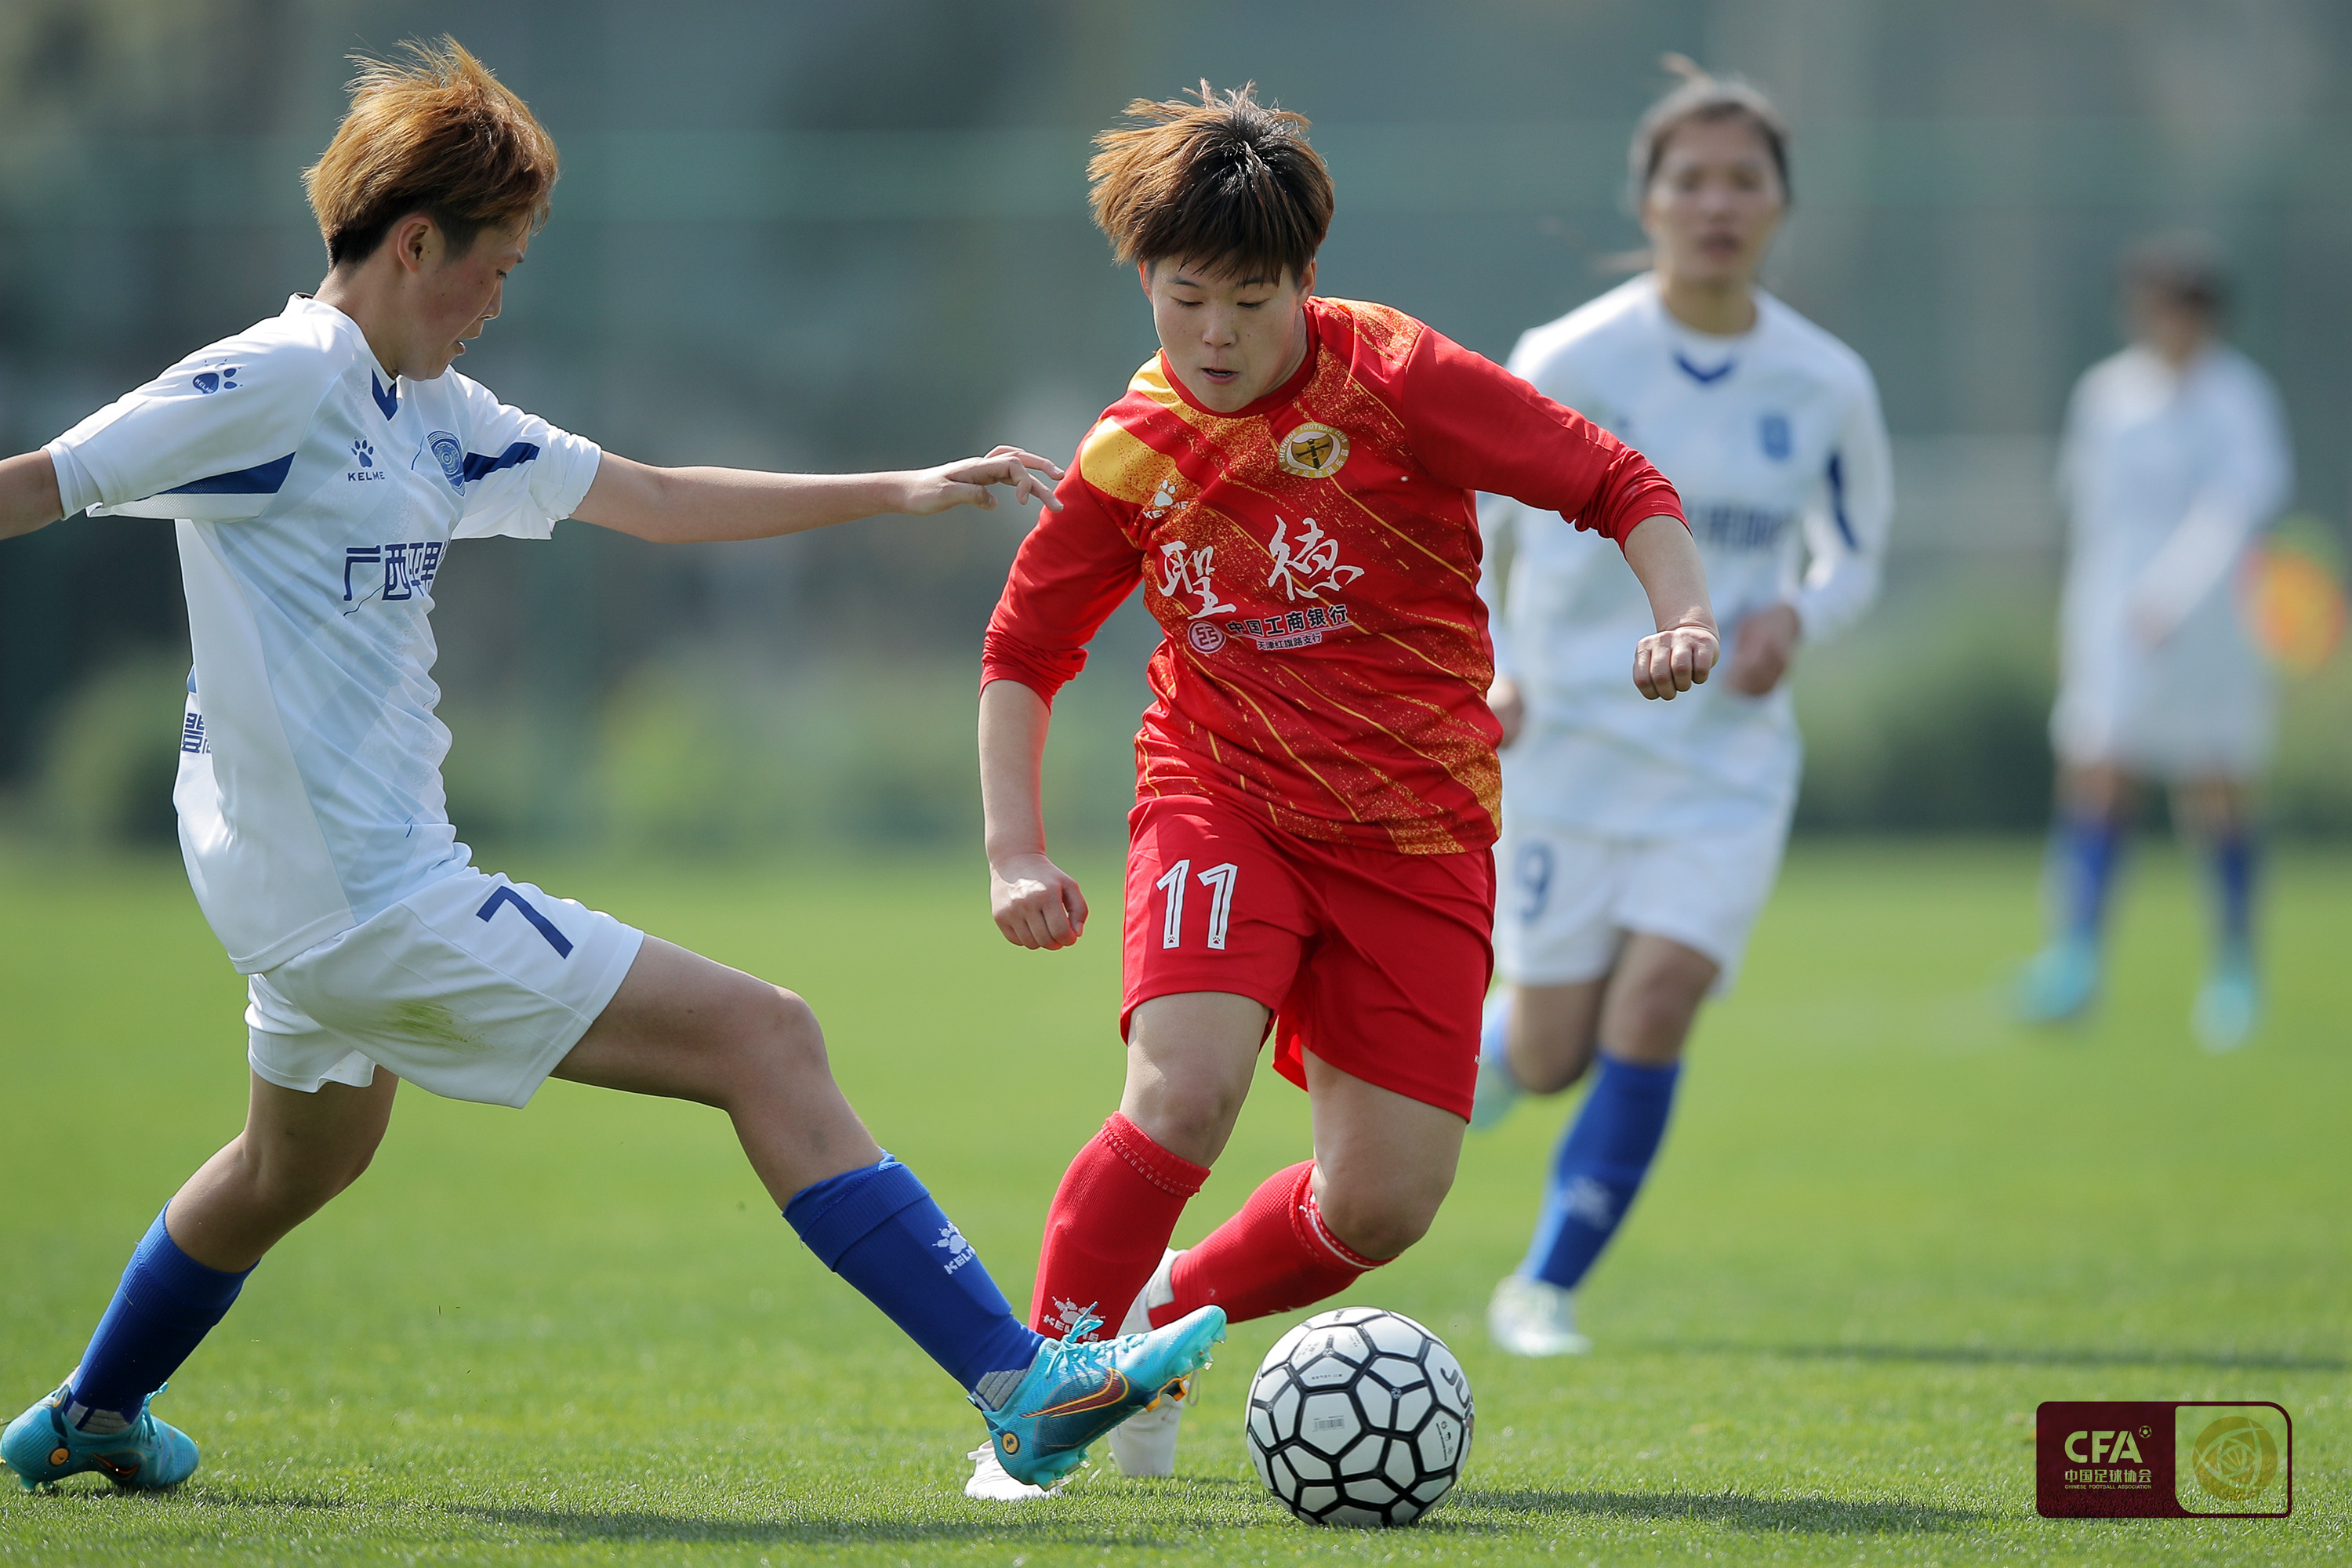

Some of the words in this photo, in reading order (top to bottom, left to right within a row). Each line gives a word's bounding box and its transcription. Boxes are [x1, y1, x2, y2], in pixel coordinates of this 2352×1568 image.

[1279, 430, 1297, 463] SHENGDE
[1334, 430, 1348, 444] CLUB
[347, 470, 386, 482] KELME
[343, 538, 451, 601] 广西平果
[1225, 604, 1348, 637] 中国工商银行
[1256, 632, 1323, 651] 天津红旗路支行
[1155, 858, 1239, 951] 11
[475, 884, 575, 960] 7
[1043, 1314, 1099, 1342] KELE
